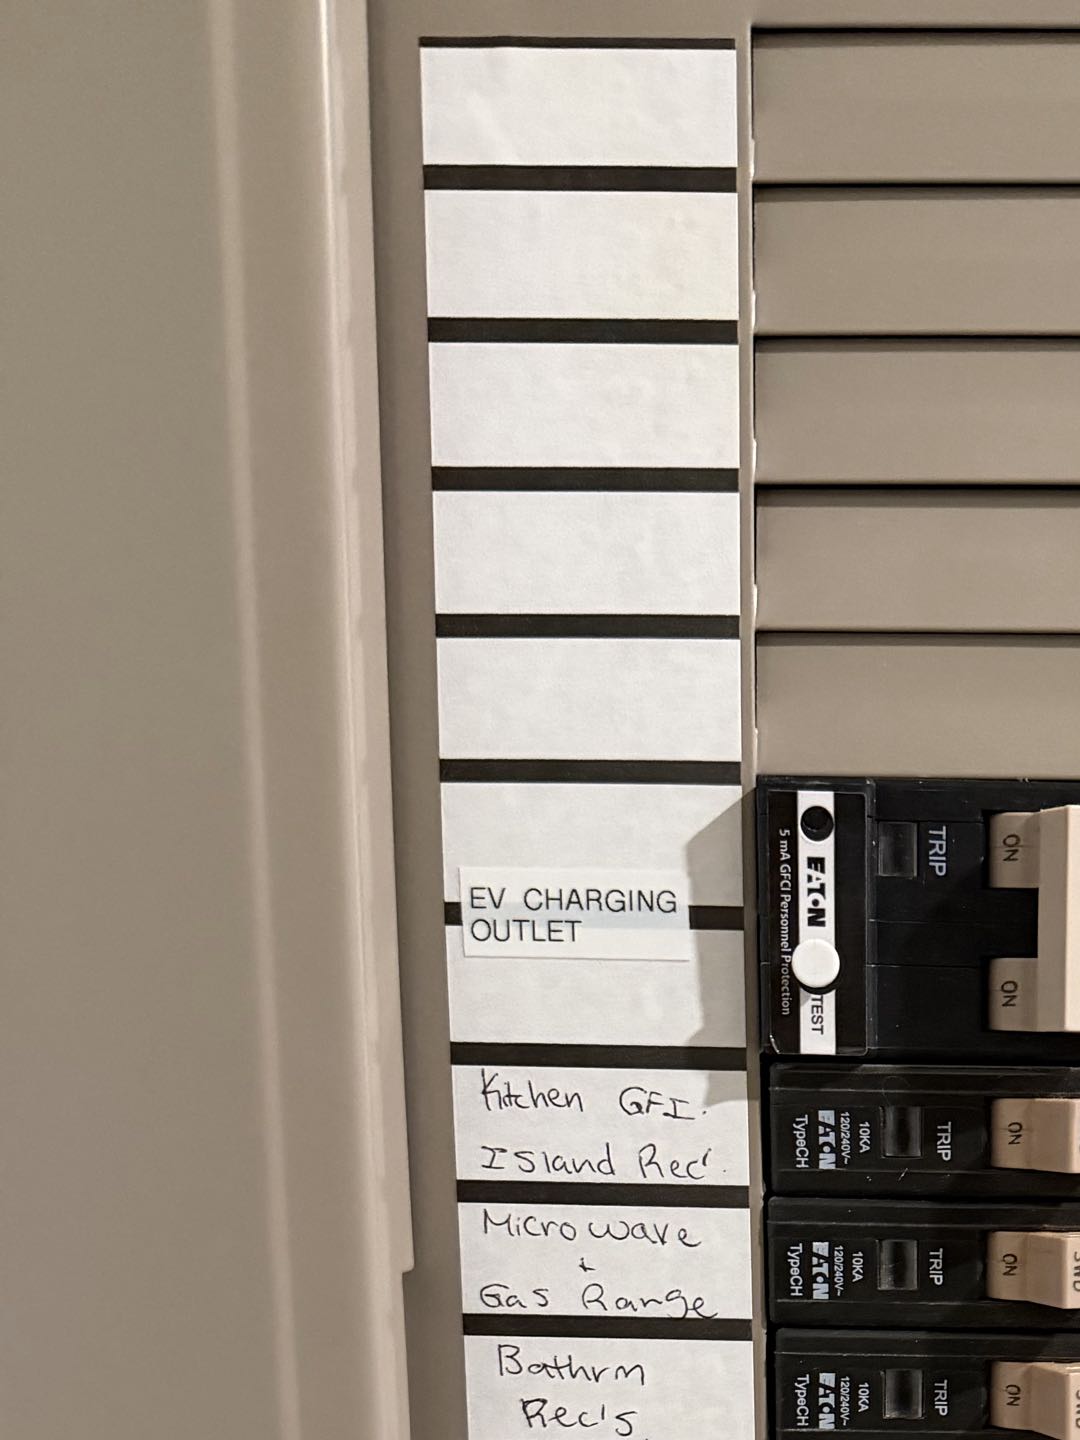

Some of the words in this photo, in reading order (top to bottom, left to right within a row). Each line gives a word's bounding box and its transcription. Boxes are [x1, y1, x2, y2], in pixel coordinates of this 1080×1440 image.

[779, 828, 790, 837] 5
[1001, 833, 1021, 862] ON
[779, 839, 791, 861] mA
[928, 825, 947, 877] TRIP
[779, 863, 791, 892] GFCI
[470, 887, 506, 910] EV
[523, 888, 677, 914] CHARGING
[470, 918, 583, 942] OUTLET
[779, 894, 792, 953] Personnel
[780, 954, 792, 1016] Protection
[1000, 980, 1019, 1008] ON
[811, 994, 824, 1035] TEST
[481, 1067, 584, 1113] Kitchen
[859, 1121, 871, 1153] 10KA
[936, 1121, 952, 1162] TRIP
[1007, 1121, 1023, 1146] ON
[479, 1283, 550, 1309] Gas
[581, 1283, 719, 1320] Range
